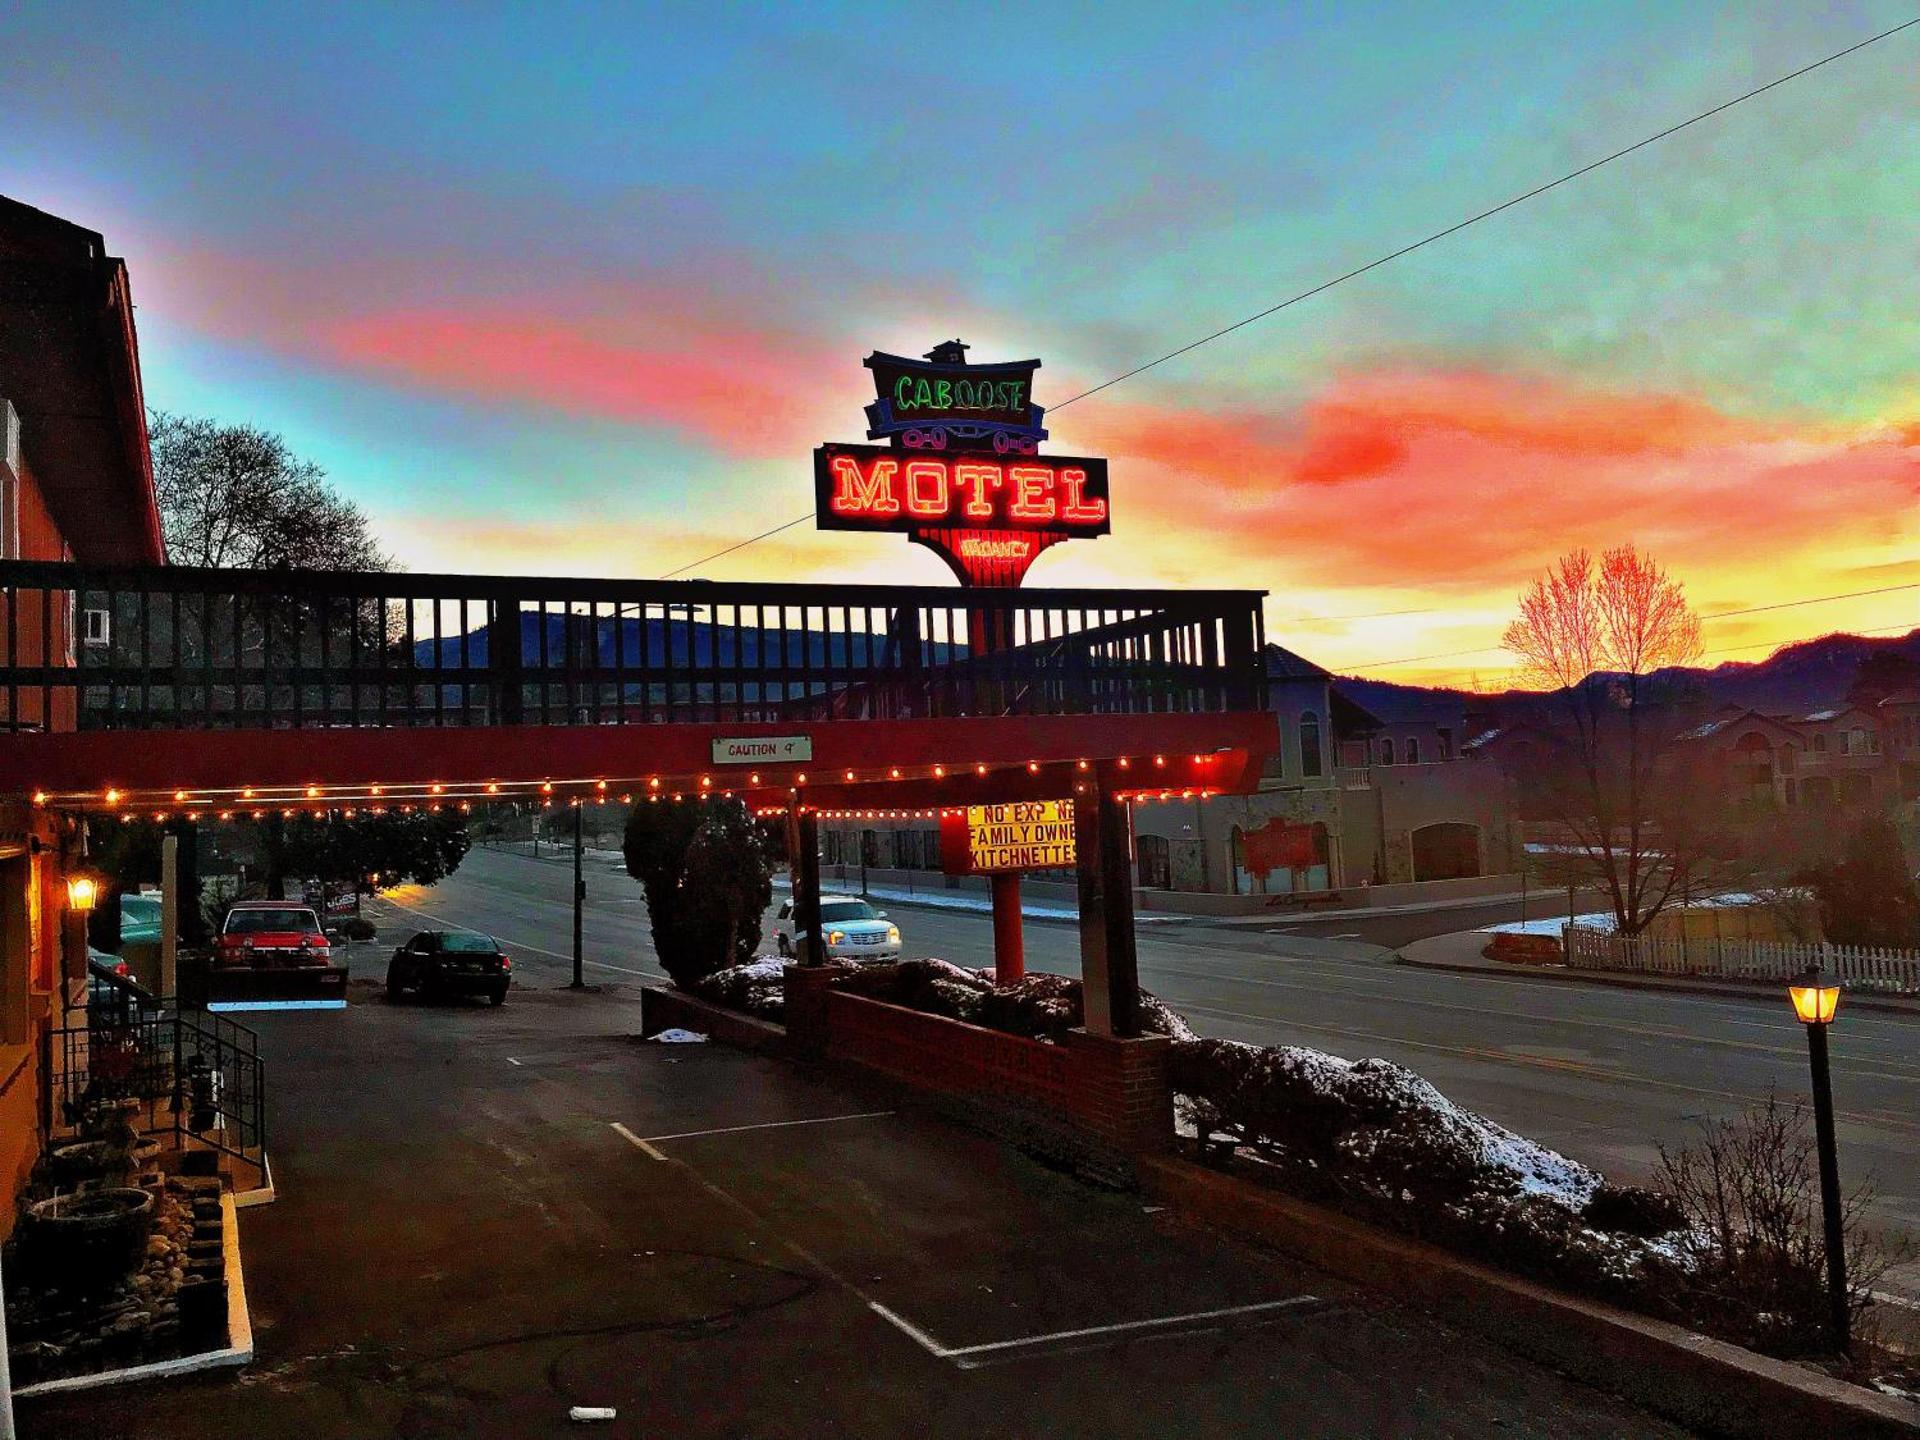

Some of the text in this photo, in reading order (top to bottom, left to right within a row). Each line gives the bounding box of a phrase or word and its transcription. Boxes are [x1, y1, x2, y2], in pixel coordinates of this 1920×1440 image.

[894, 376, 1025, 411] CABOOSE
[833, 457, 1106, 519] MOTEL
[960, 538, 1030, 558] VACANCY
[728, 743, 776, 756] CAUTION
[983, 804, 1005, 824] NO
[1014, 803, 1045, 822] EXP
[969, 825, 1030, 846] FAMILY
